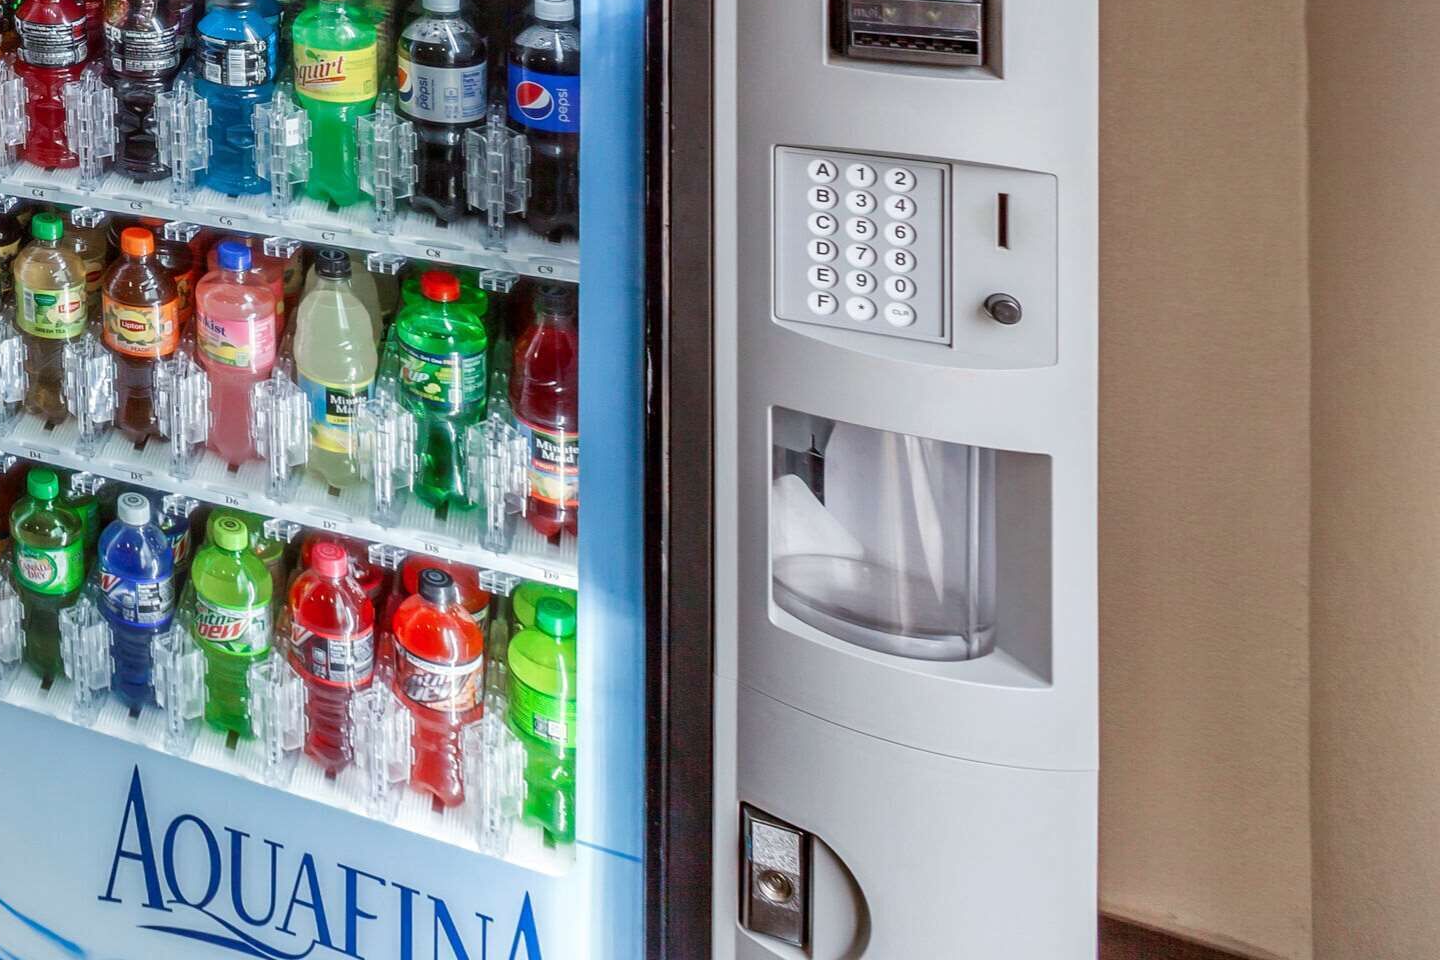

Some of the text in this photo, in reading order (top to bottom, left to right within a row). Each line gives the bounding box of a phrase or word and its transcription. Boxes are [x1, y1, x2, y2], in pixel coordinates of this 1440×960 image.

[555, 87, 571, 123] pepsi
[816, 163, 907, 185] A 1 2
[816, 189, 907, 212] B 3 4
[31, 189, 45, 197] C4
[218, 215, 233, 226] C6
[321, 231, 336, 241] C7
[425, 248, 441, 258] C8
[537, 265, 554, 274] C9
[816, 215, 907, 239] C 5 6
[816, 242, 907, 266] D 7 8
[816, 268, 907, 293] E 9 0
[817, 294, 910, 317] F CLR
[121, 320, 145, 330] Lipton
